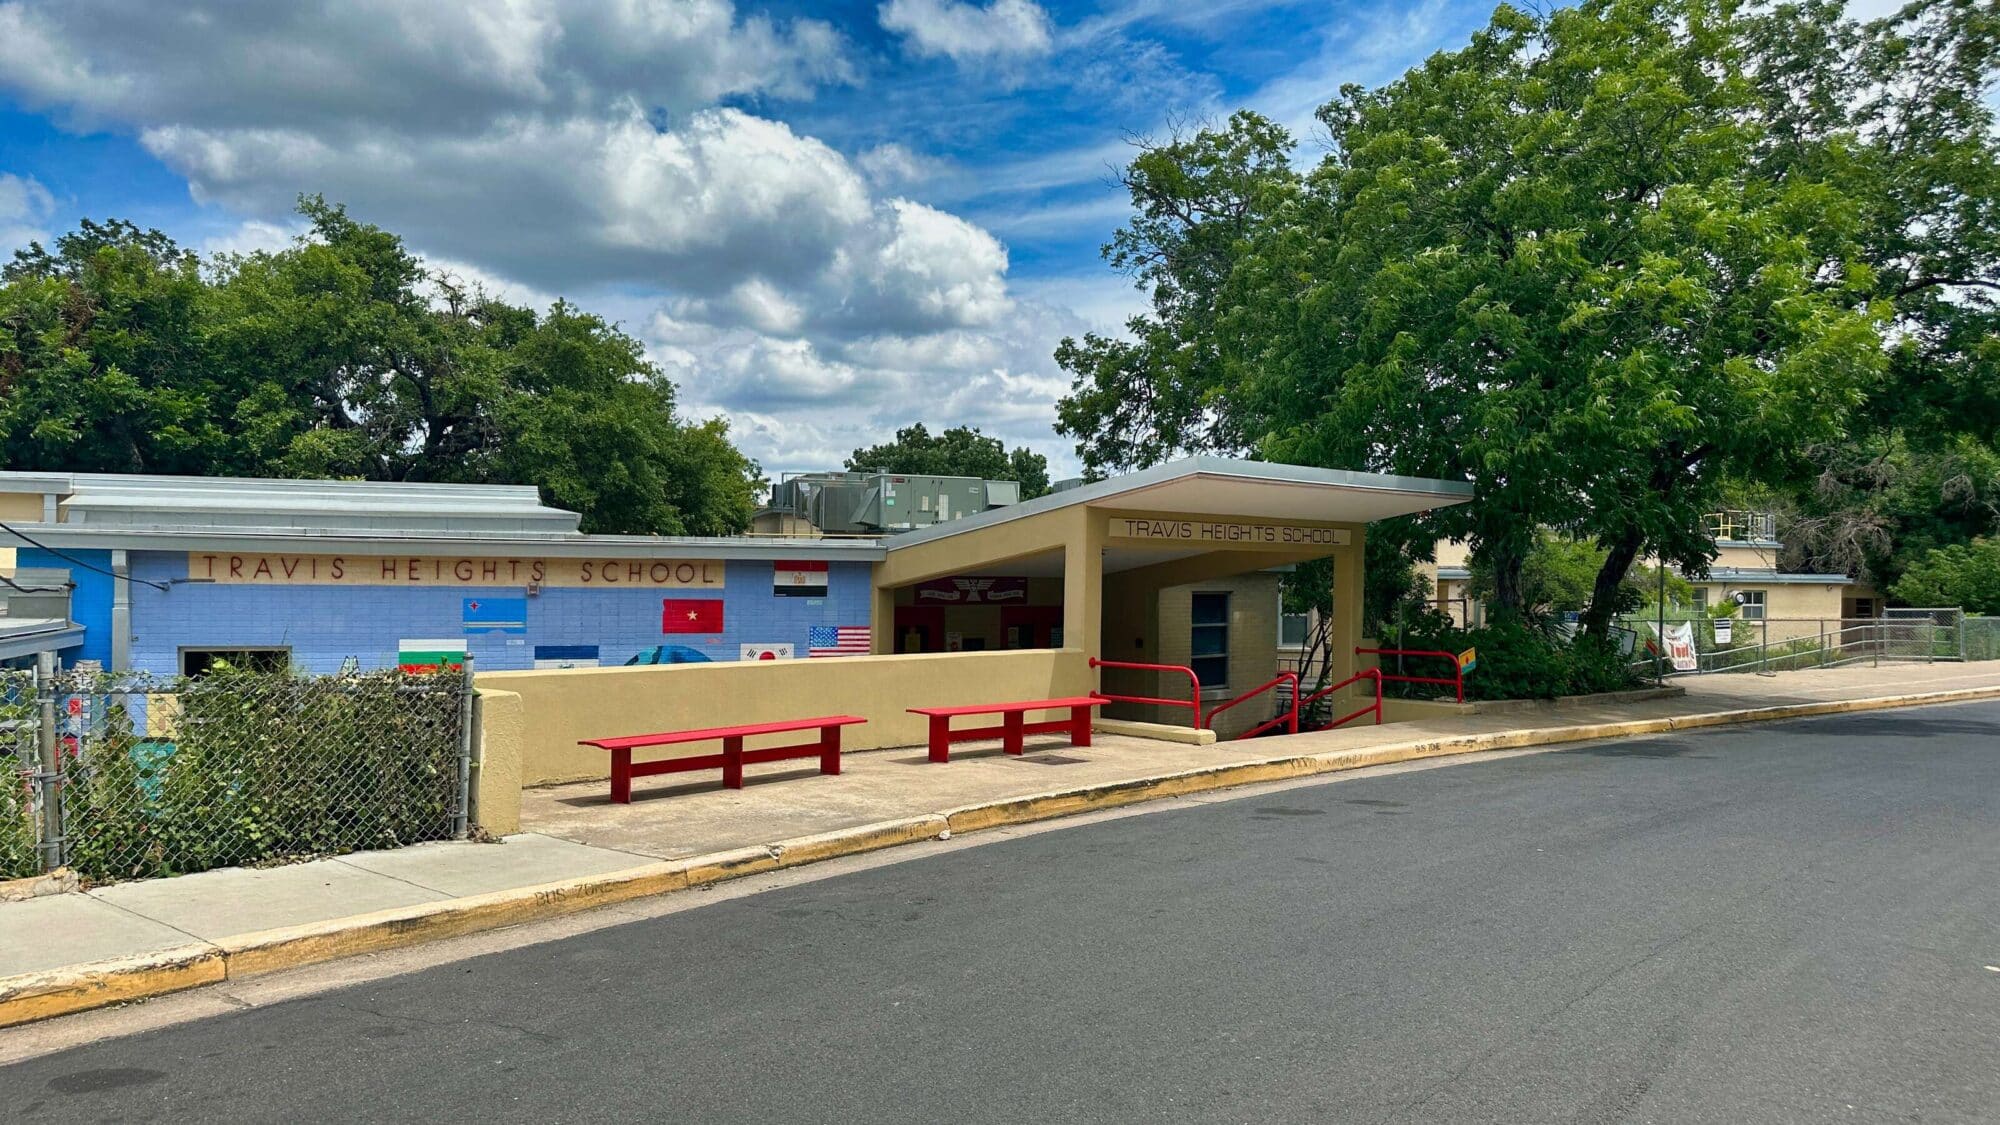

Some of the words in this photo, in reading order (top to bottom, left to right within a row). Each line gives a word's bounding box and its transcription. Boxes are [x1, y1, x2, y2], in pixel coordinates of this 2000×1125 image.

[1125, 520, 1192, 538] TRAVIS
[1201, 524, 1275, 541] HEIGHTS
[1283, 527, 1340, 544] SCHOOL
[202, 554, 346, 580] TRAVIS
[381, 558, 545, 582] HEIGHTS
[580, 560, 715, 584] SCHOOL
